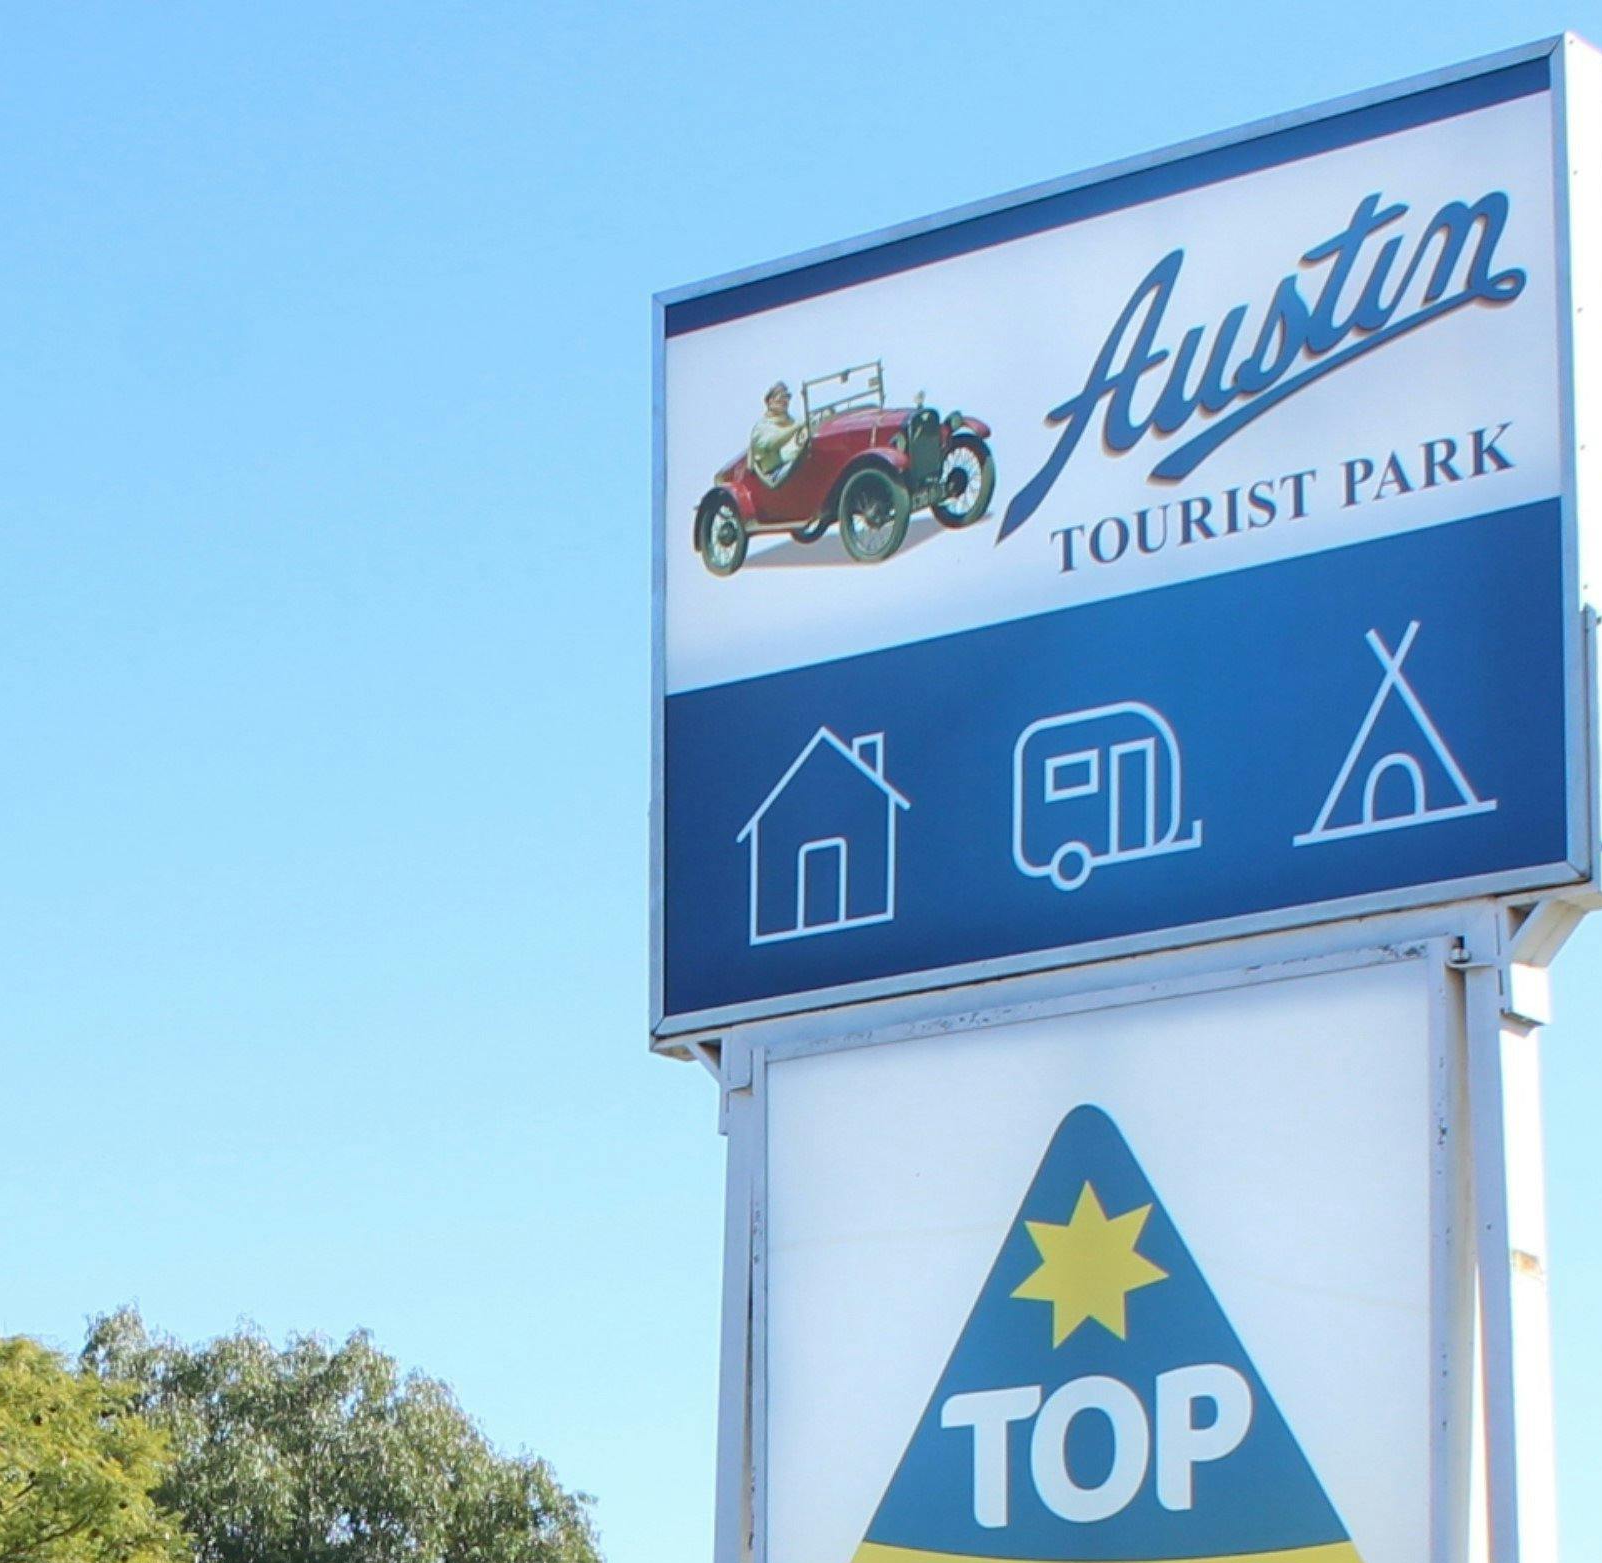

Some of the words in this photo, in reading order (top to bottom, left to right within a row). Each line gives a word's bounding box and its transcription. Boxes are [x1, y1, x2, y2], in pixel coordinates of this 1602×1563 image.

[995, 190, 1528, 546] Austin
[1050, 469, 1317, 573] TOURIST
[1341, 421, 1515, 508] PARK
[940, 1363, 1254, 1529] TOP
